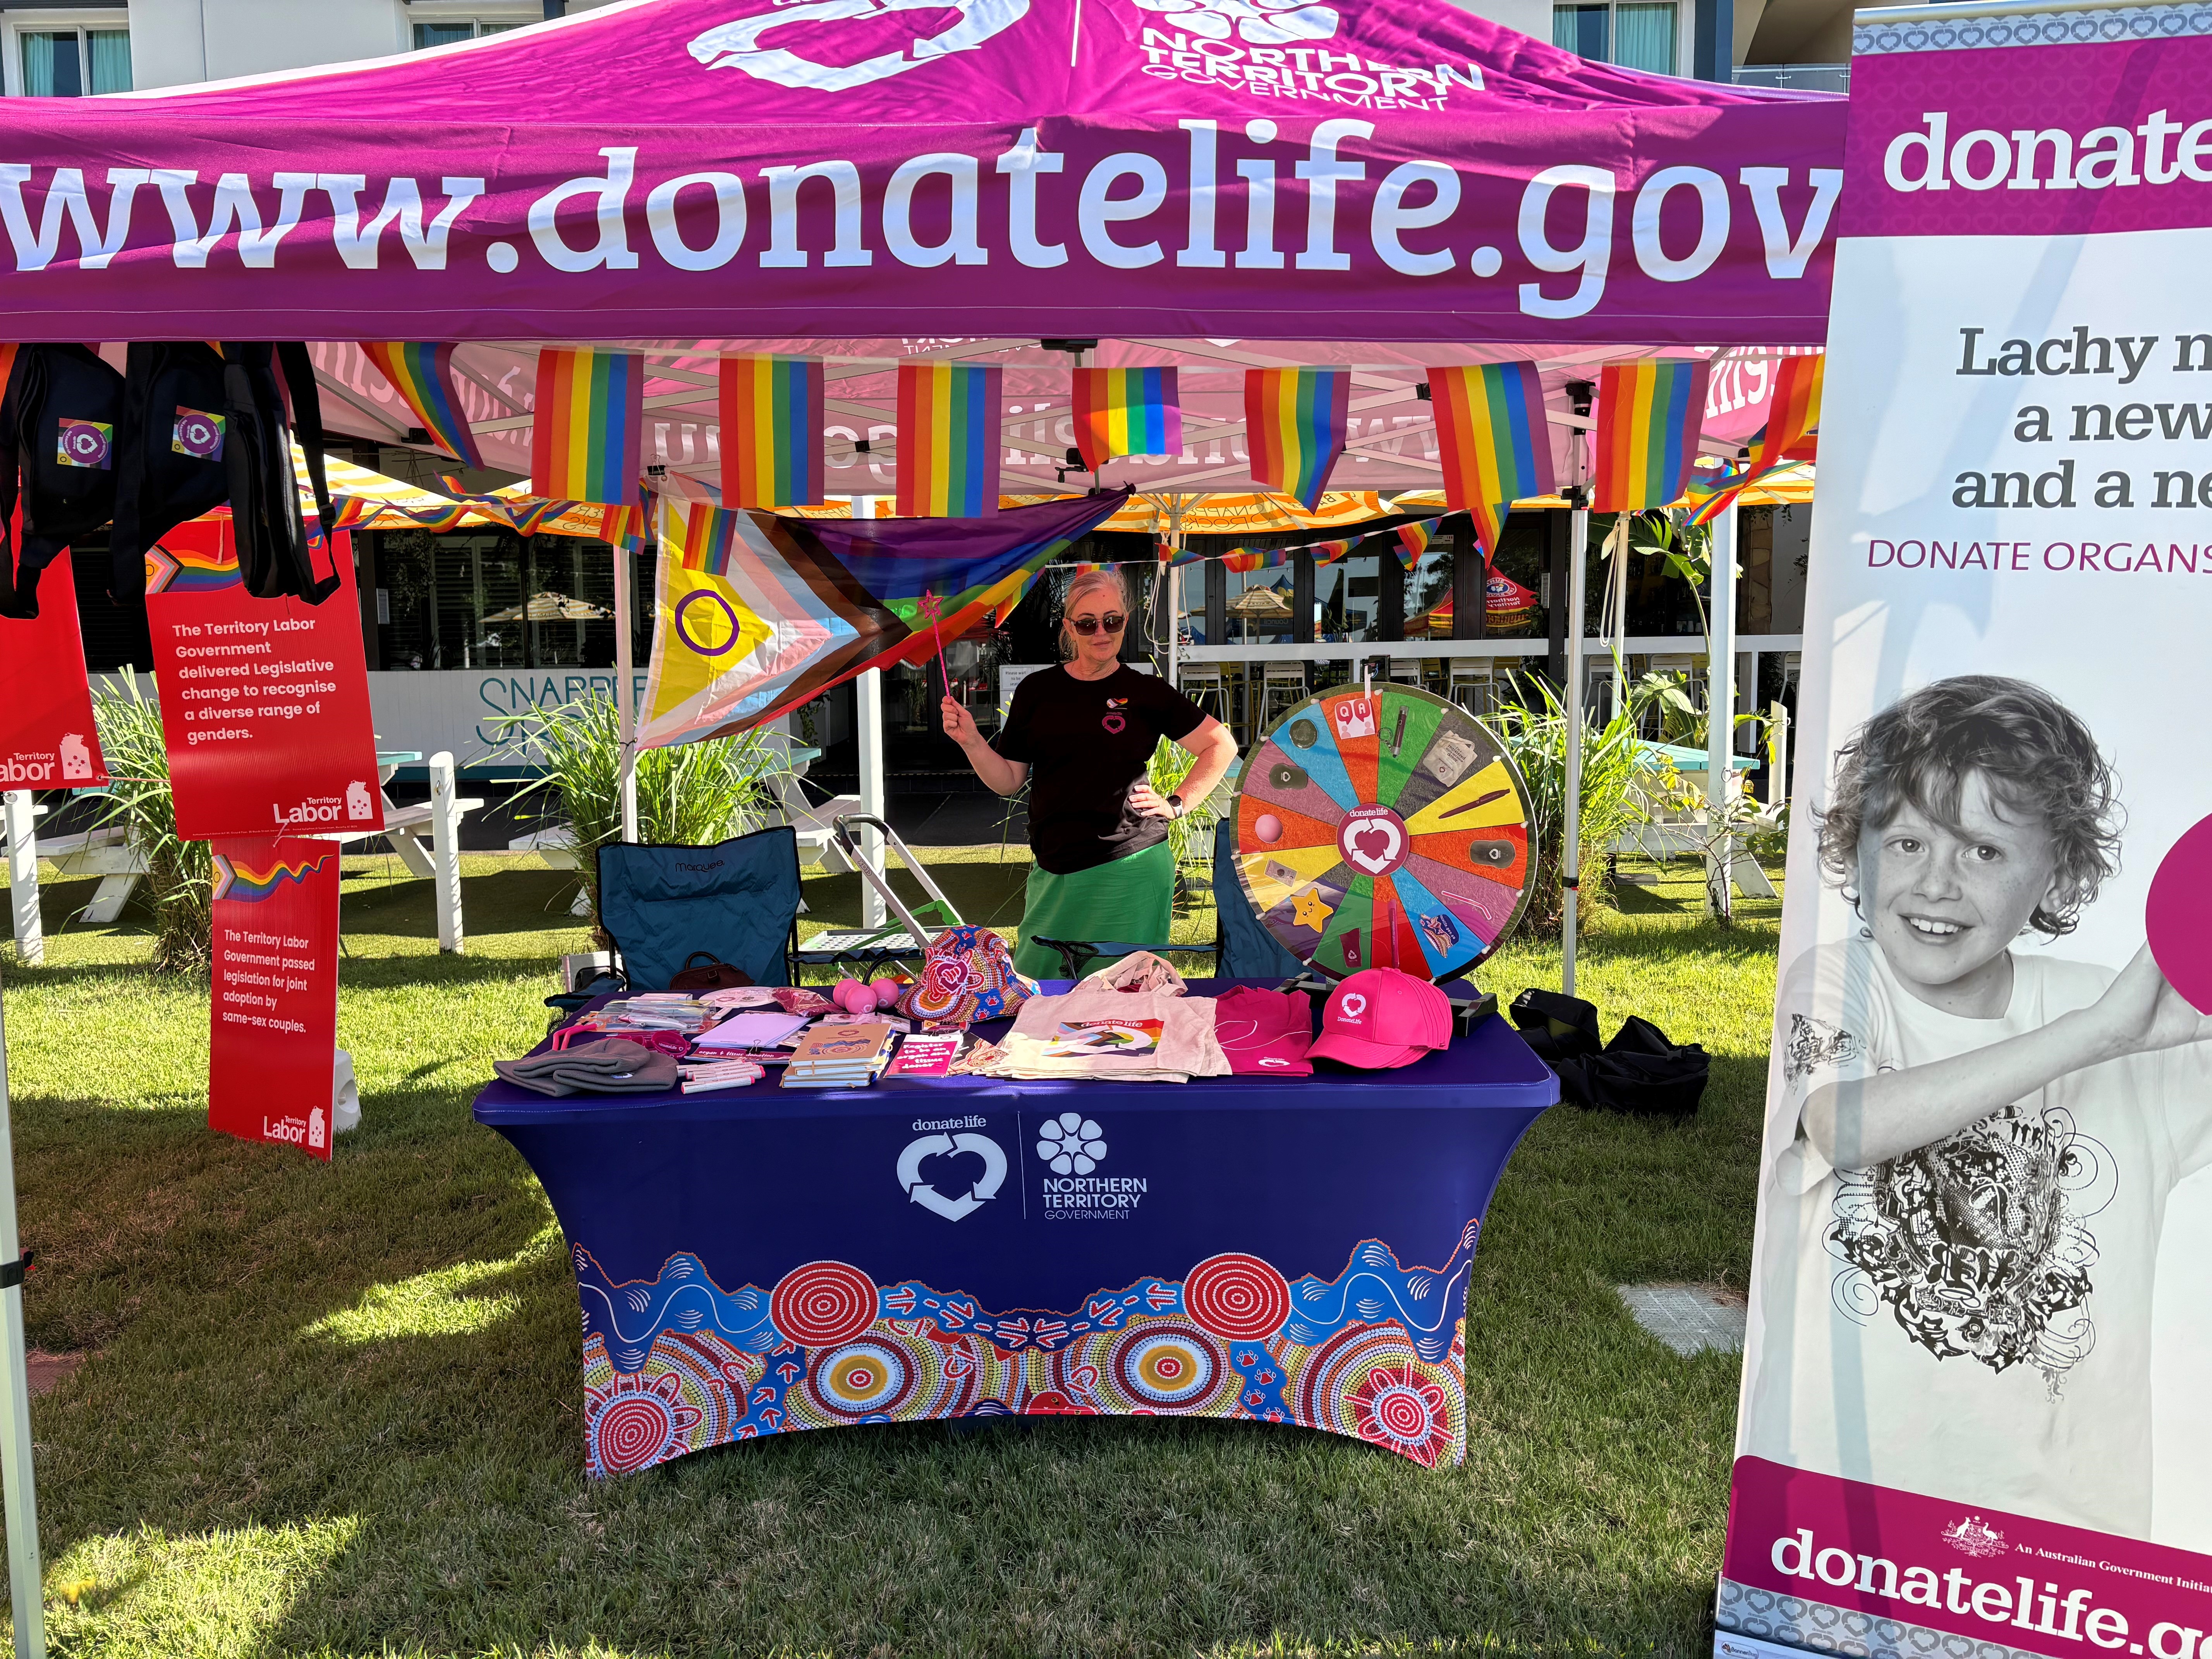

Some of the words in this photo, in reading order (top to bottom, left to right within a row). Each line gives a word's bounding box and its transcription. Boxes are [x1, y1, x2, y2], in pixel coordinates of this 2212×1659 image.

[1142, 27, 1485, 91] NORTHERN
[1140, 44, 1449, 98] TERRITORY
[1141, 64, 1449, 111] GOVERNMENT
[1956, 326, 2159, 384] Lachy
[2014, 405, 2052, 443] a
[1952, 459, 2076, 509] and
[2094, 471, 2134, 508] a
[1868, 539, 2031, 571] DONATE
[172, 624, 201, 637] The
[204, 620, 270, 639] Territory
[273, 618, 316, 632] Labor
[175, 641, 271, 658] Government
[179, 664, 250, 680] delivered
[253, 659, 334, 678] Legislative
[182, 687, 240, 704] change
[243, 685, 259, 697] to
[263, 681, 337, 700] recognise
[184, 711, 195, 721] a
[198, 705, 254, 721] diverse
[258, 705, 303, 720] range
[306, 702, 321, 715] of
[1340, 707, 1350, 717] Q
[1358, 702, 1366, 714] A
[187, 728, 253, 745] genders.
[13, 752, 55, 761] Territory
[1447, 753, 1458, 762] donor
[1448, 744, 1466, 760] registered
[307, 796, 343, 805] Territory
[273, 802, 343, 824] Labor
[224, 929, 241, 943] The
[242, 931, 281, 950] Territory
[282, 934, 309, 950] Labor
[224, 950, 280, 967] Government
[282, 957, 315, 971] passed
[223, 969, 270, 989] legislation
[271, 974, 285, 987] for
[285, 977, 307, 993] joint
[223, 990, 264, 1008] adoption
[265, 995, 278, 1011] by
[222, 1011, 266, 1027] same-sex
[268, 1015, 307, 1034] couples.
[264, 1115, 306, 1144] Labor
[285, 1115, 307, 1128] Territory
[1043, 1178, 1147, 1193] NORTHERN
[1042, 1194, 1141, 1208] TERRITORY
[1044, 1210, 1130, 1220] GOVERNMENT
[2015, 1543, 2033, 1554] An
[2035, 1547, 2096, 1568] Australian
[2099, 1560, 2174, 1585] Government
[2176, 1576, 2212, 1594] Initia
